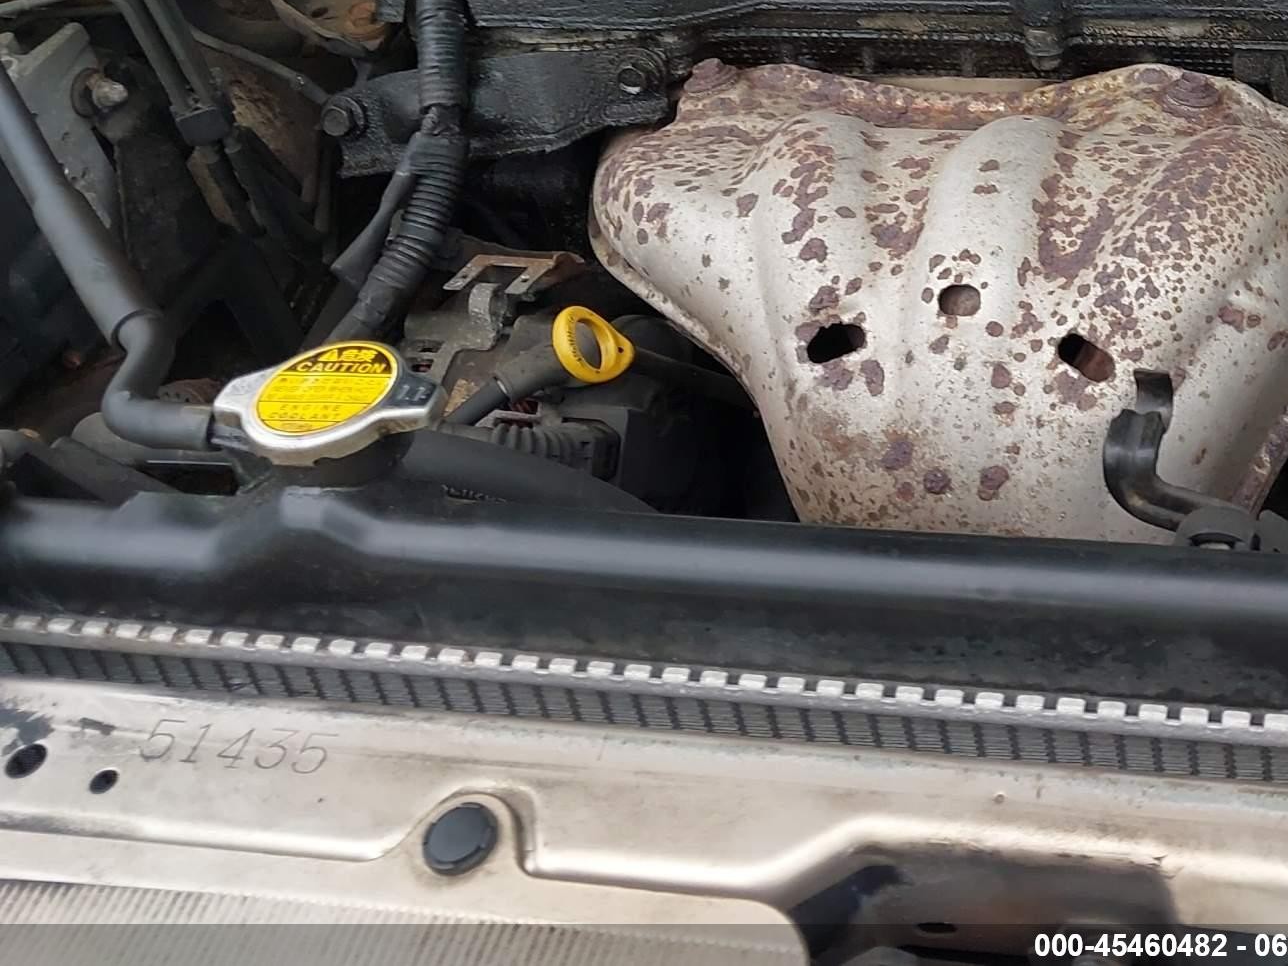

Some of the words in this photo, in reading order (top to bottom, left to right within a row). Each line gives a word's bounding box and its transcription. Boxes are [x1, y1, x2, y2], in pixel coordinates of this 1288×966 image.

[296, 362, 386, 373] CAUTION
[268, 411, 340, 420] COOLANT
[139, 718, 339, 775] 51435
